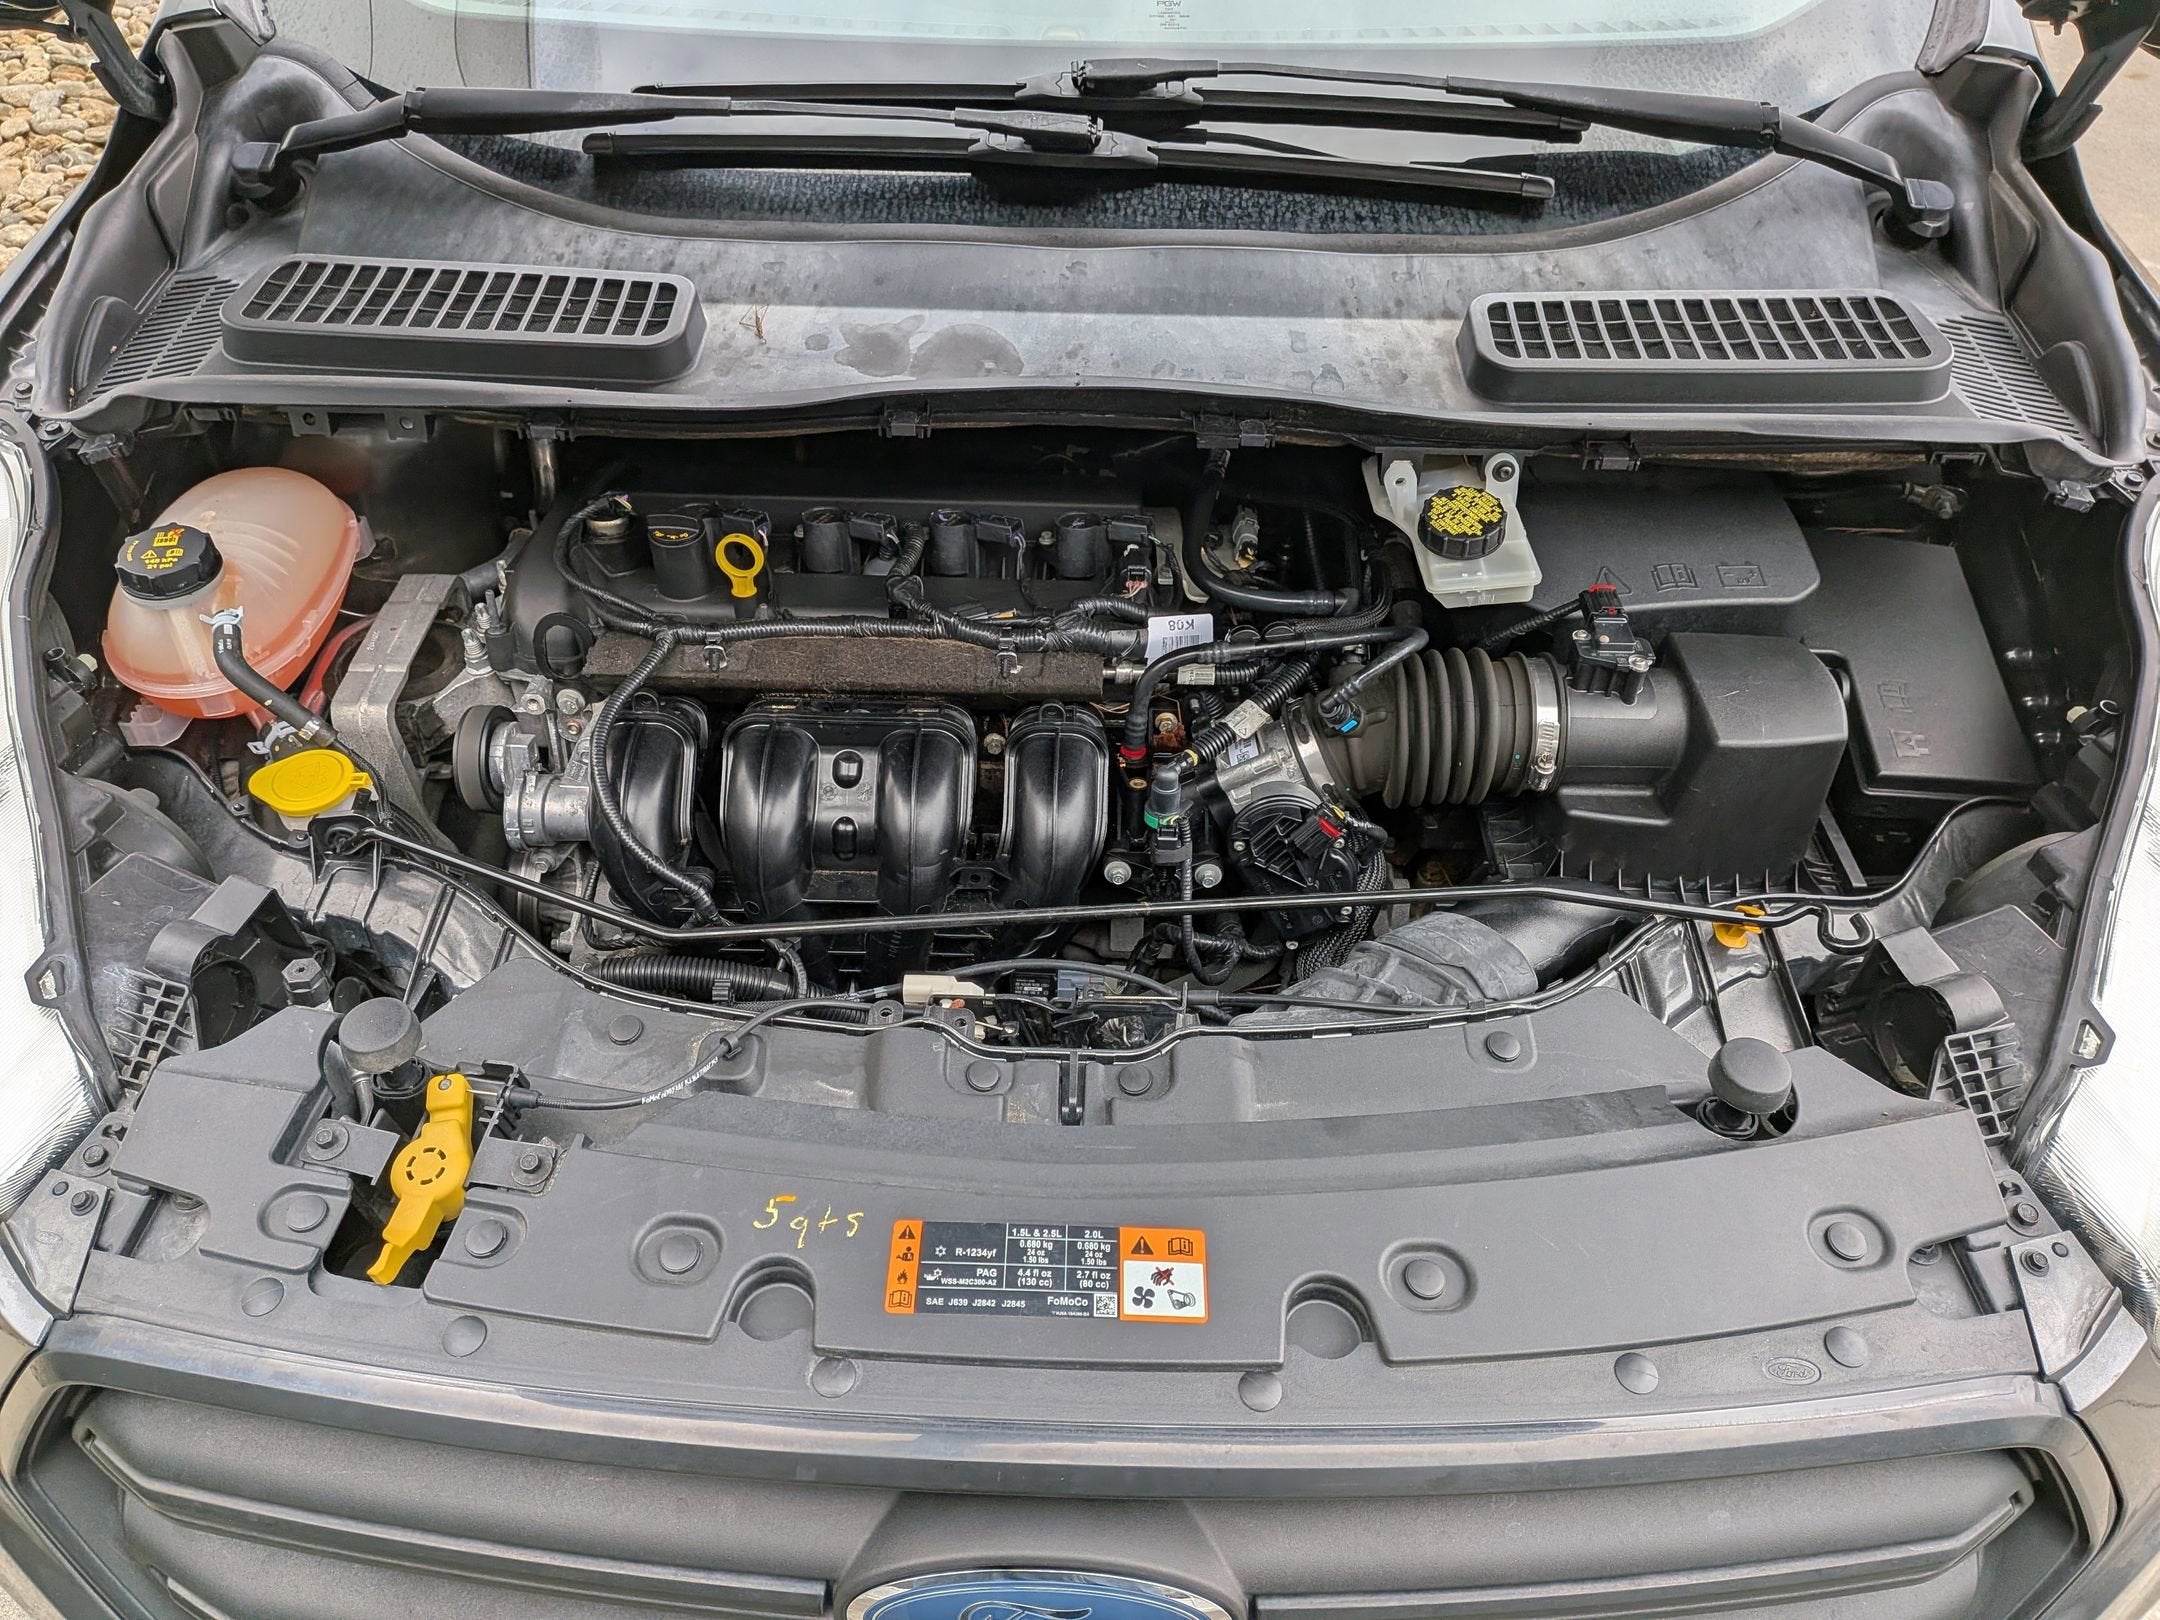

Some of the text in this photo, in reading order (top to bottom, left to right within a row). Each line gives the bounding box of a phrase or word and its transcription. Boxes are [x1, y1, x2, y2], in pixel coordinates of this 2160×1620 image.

[1167, 618, 1195, 631] K08
[753, 1193, 797, 1229] 5
[1012, 1228, 1062, 1238] 1.5L & 2.5L
[1084, 1230, 1104, 1239] 2.0L
[1019, 1240, 1053, 1250] 0.680 kg
[1077, 1242, 1111, 1252] 0.680 kg
[955, 1247, 997, 1259] R-1234yf
[1038, 1256, 1049, 1264] lbs
[1096, 1258, 1107, 1266] lbs
[976, 1268, 997, 1277] PAG
[1017, 1268, 1052, 1278] 4.4 fl oz
[1076, 1270, 1090, 1279] 2.7
[1091, 1271, 1098, 1279] fl
[1017, 1278, 1053, 1288] (130 cc)
[1079, 1280, 1109, 1290] (80 cc)
[925, 1297, 1026, 1308] SAE J639 J2842 J2845
[1047, 1296, 1088, 1307] FoMoCo
